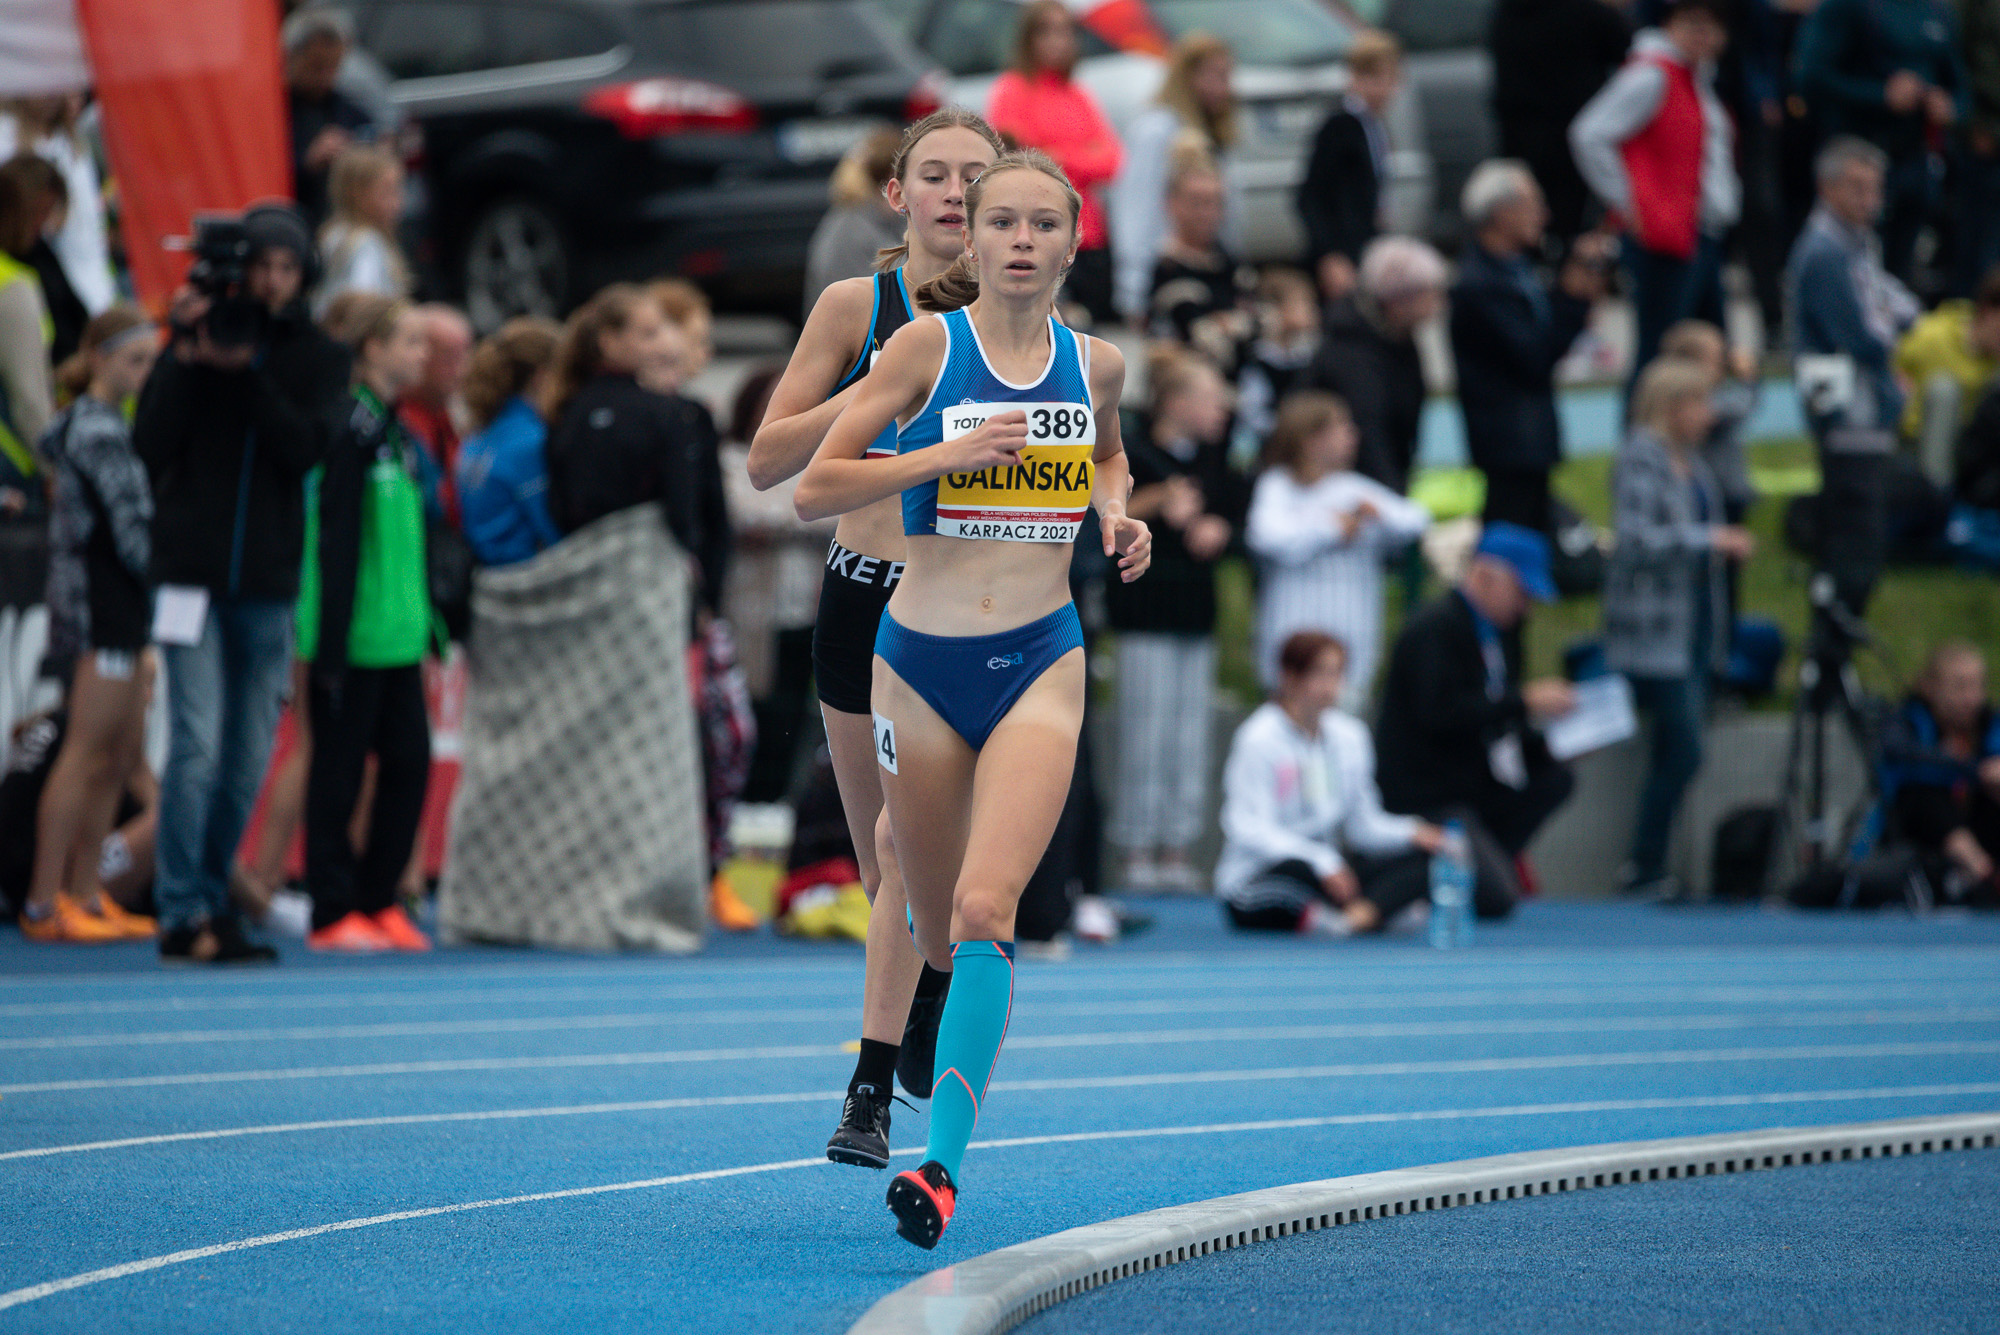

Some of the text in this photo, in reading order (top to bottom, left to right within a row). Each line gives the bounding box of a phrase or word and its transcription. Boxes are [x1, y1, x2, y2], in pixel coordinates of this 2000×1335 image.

[1031, 408, 1088, 439] 389
[946, 455, 1089, 491] GALIŃSKA
[959, 523, 1074, 540] KARPACZ 2021
[827, 538, 881, 585] IKE
